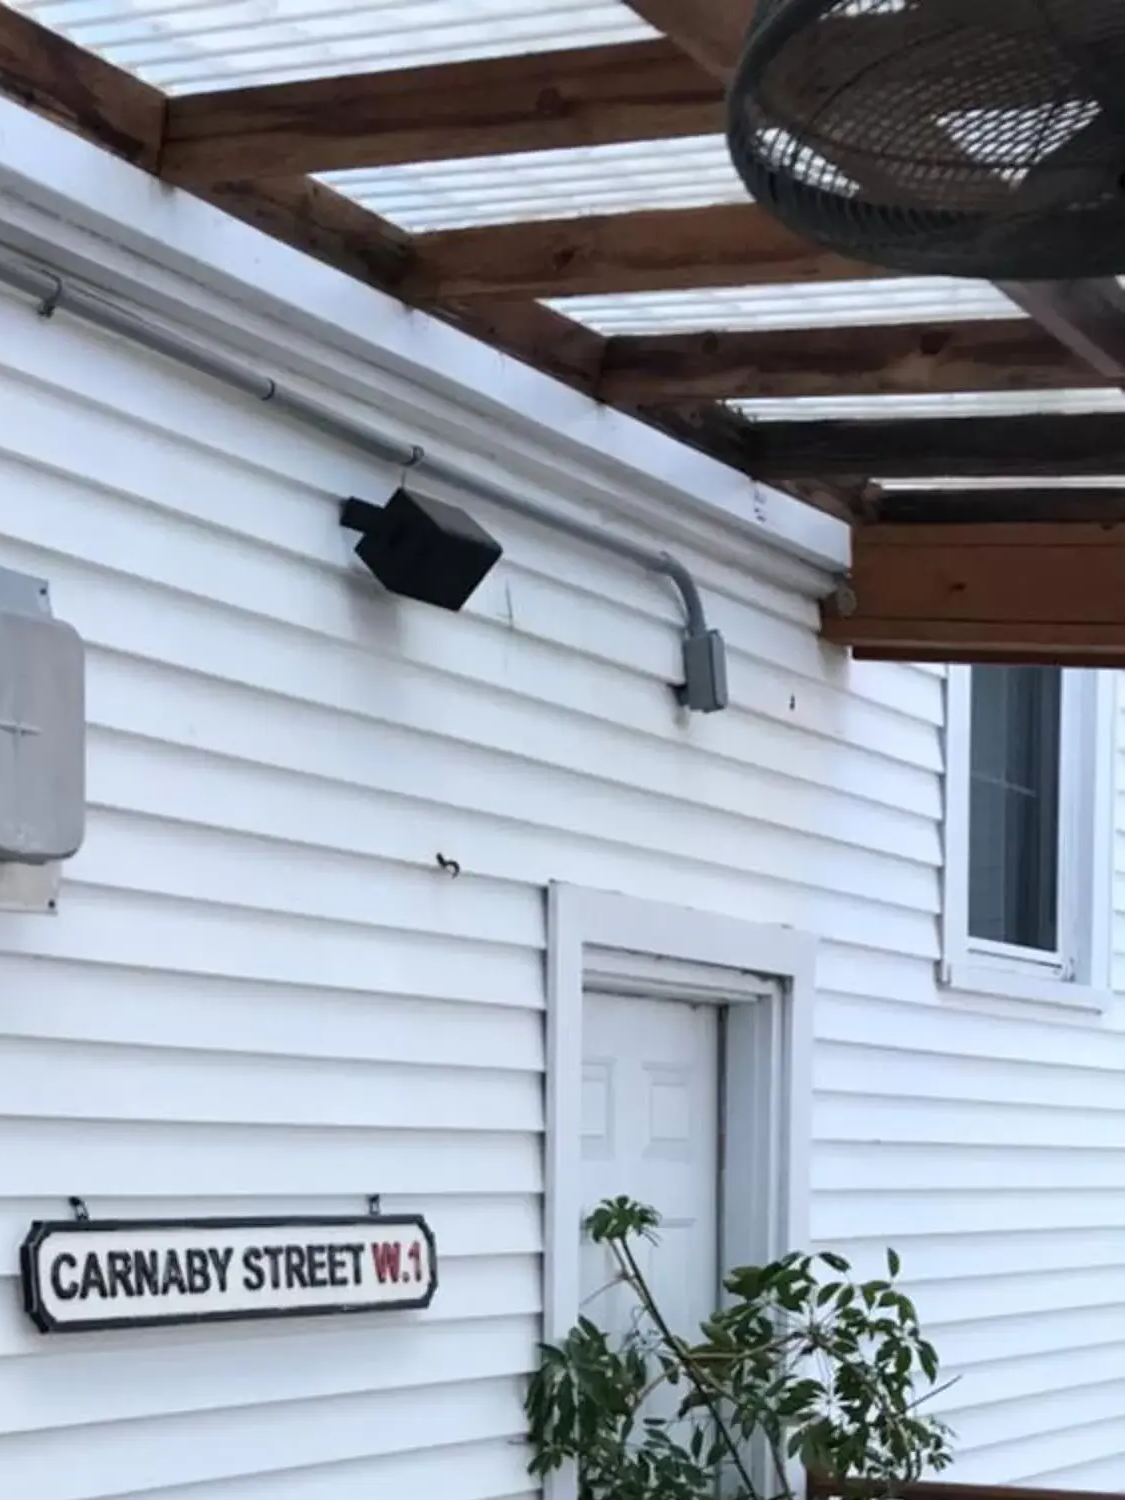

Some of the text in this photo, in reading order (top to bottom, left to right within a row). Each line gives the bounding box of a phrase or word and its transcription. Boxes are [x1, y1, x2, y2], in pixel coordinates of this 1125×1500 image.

[50, 1241, 423, 1301] CARNABY STREET W.1
